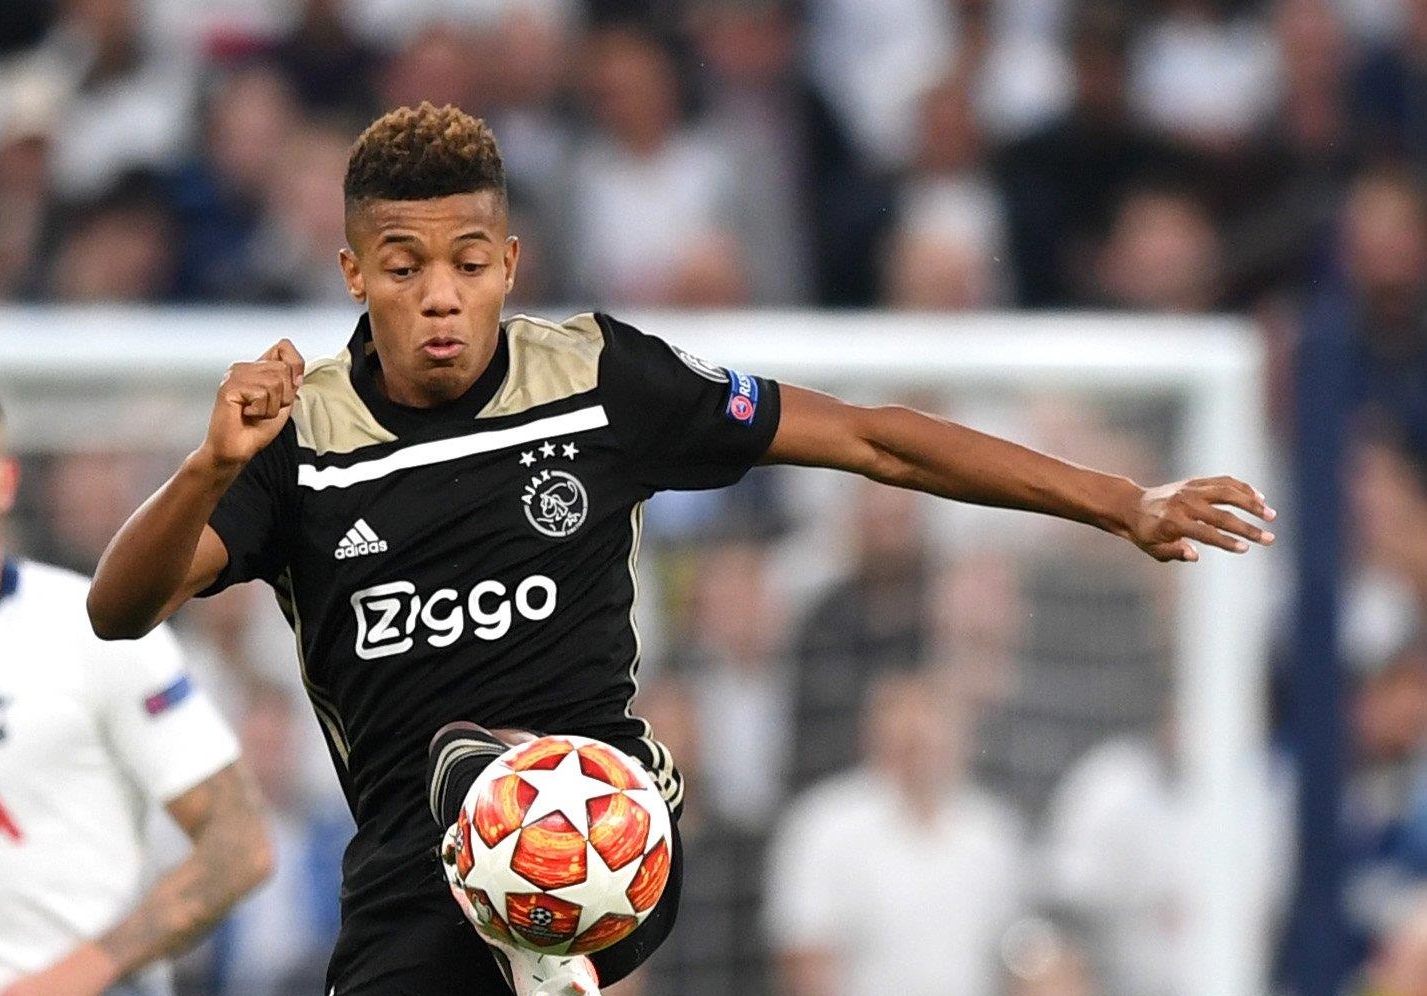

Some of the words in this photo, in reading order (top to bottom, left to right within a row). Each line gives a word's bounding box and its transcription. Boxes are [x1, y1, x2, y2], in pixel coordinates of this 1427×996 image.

[521, 469, 551, 505] AJAX
[334, 540, 388, 560] adidas
[350, 575, 557, 660] Ziggo
